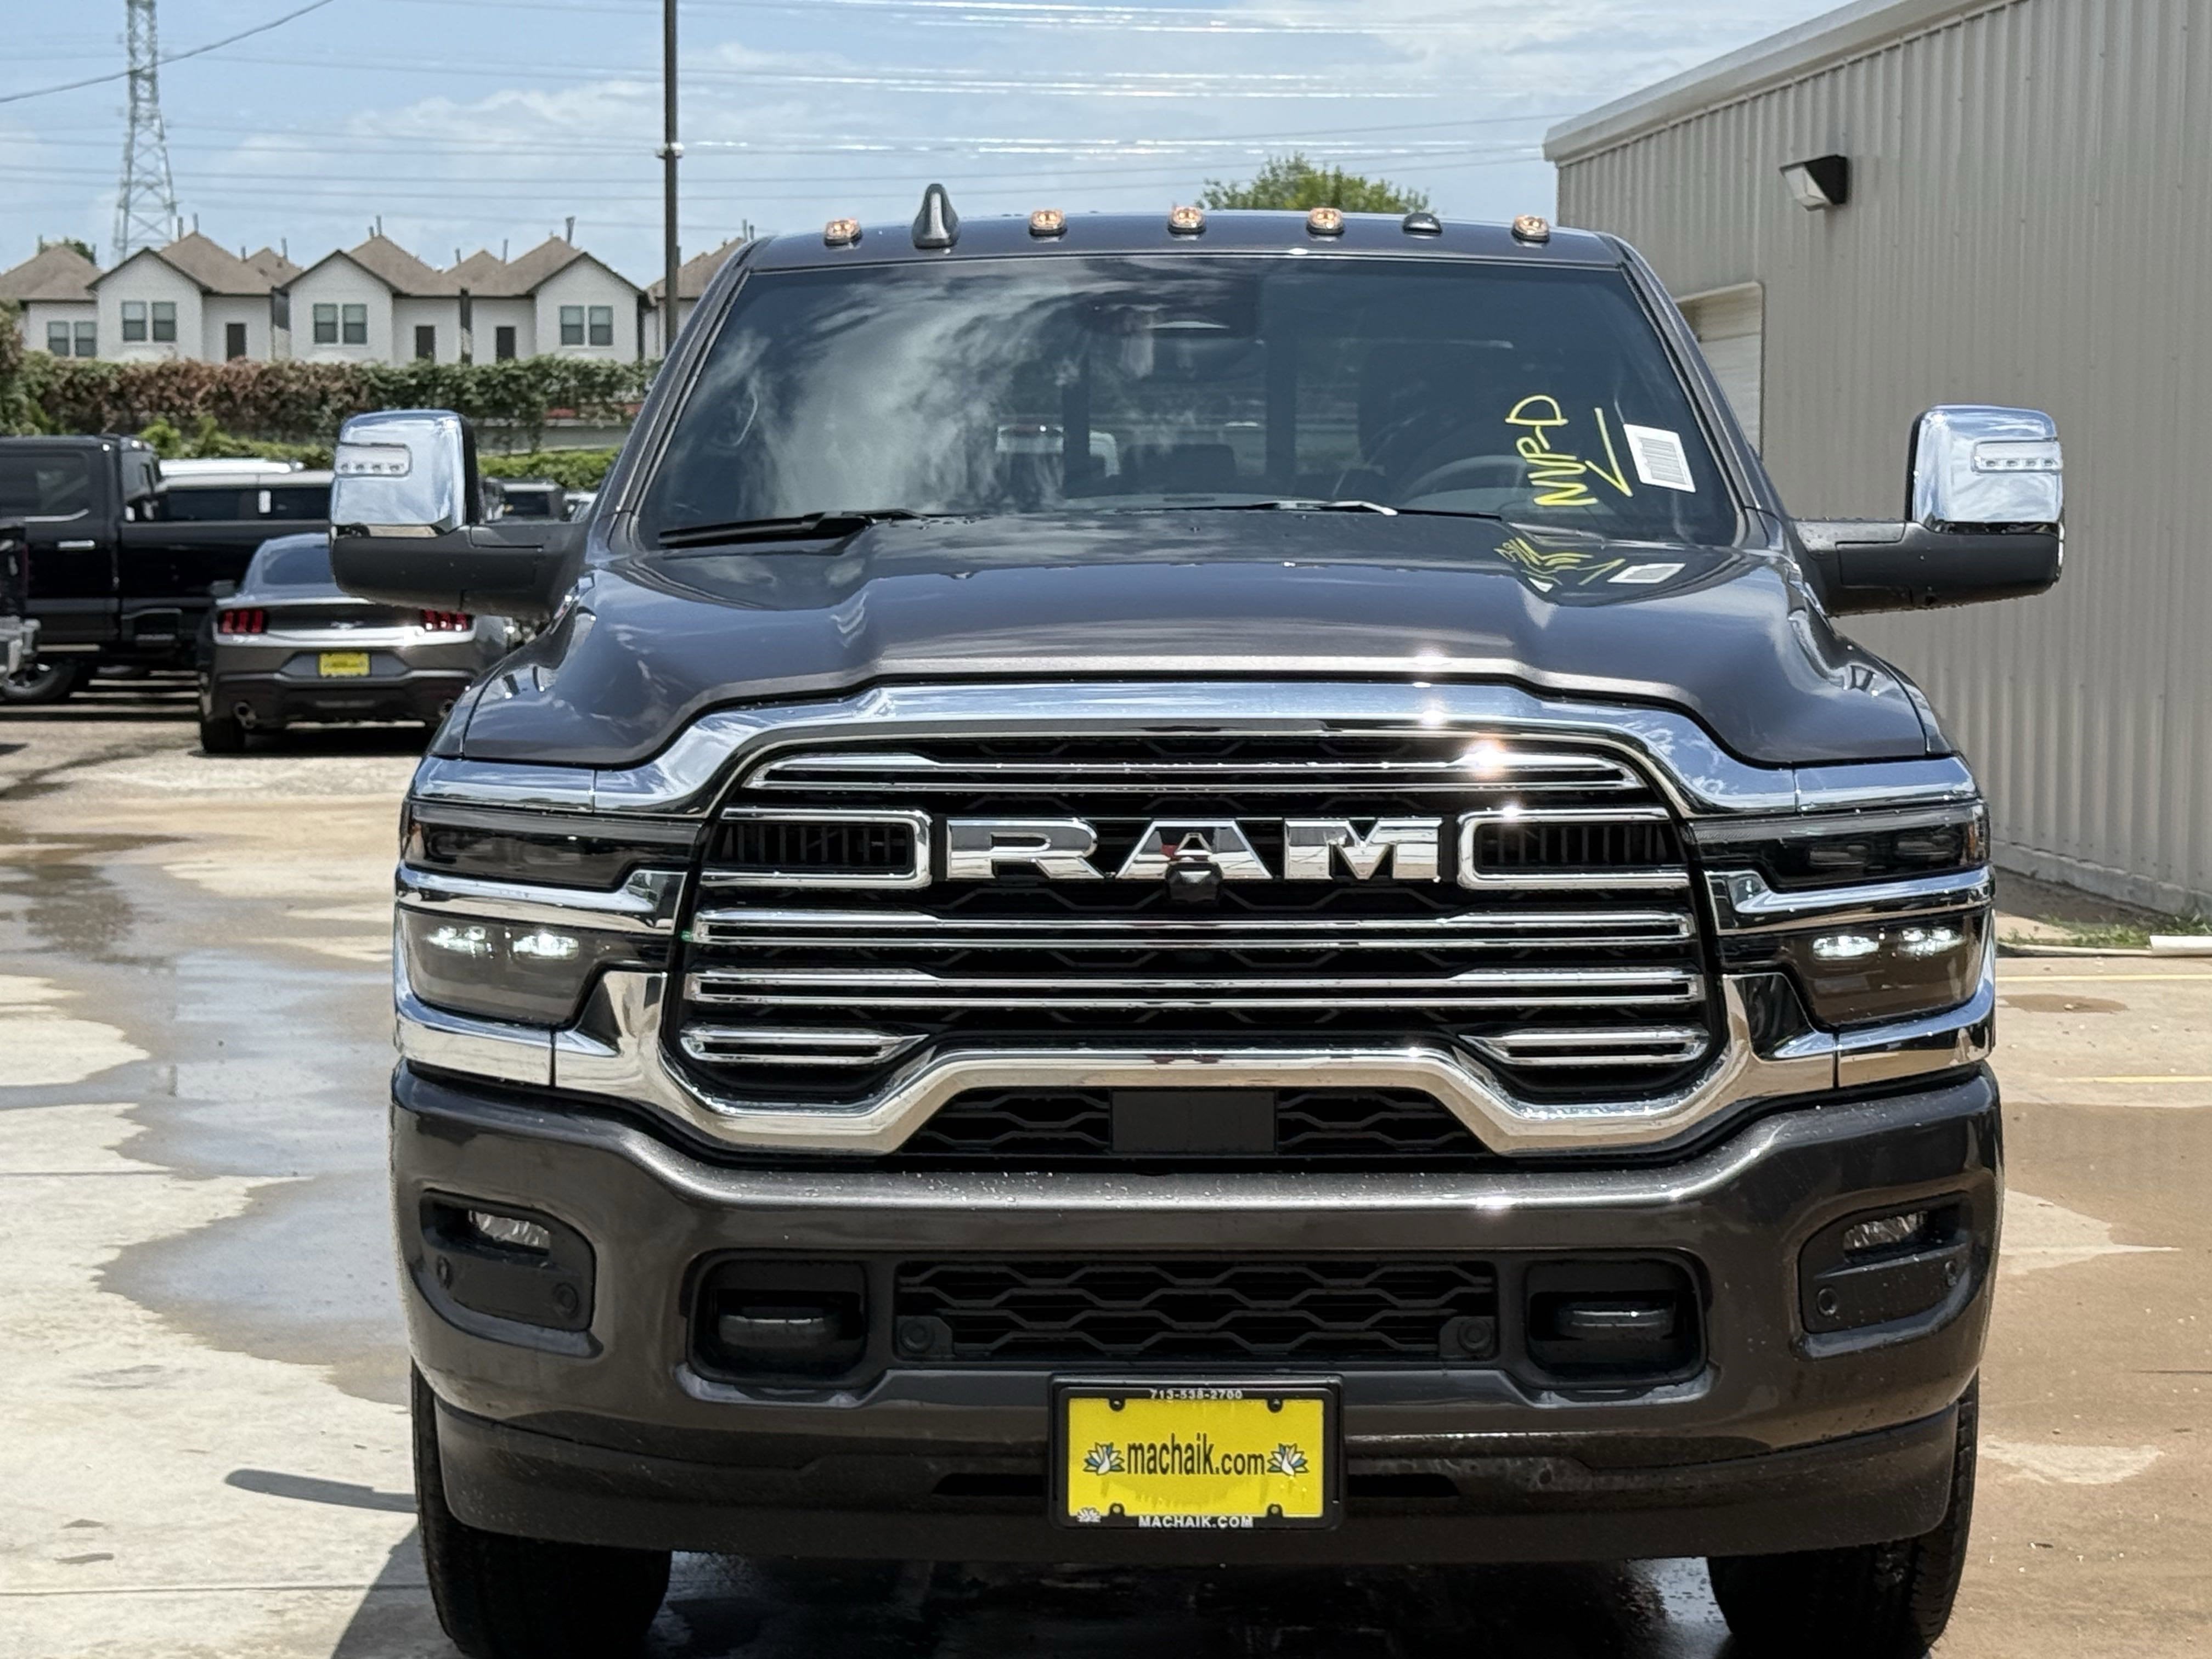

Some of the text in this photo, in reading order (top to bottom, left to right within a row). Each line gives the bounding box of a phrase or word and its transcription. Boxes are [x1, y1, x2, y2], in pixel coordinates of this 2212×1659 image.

[946, 817, 1443, 879] RAM
[1150, 1389, 1244, 1400] 713-538-2700
[1127, 1432, 1266, 1475] machaik.com
[1138, 1515, 1254, 1528] MACHAIK.COM
